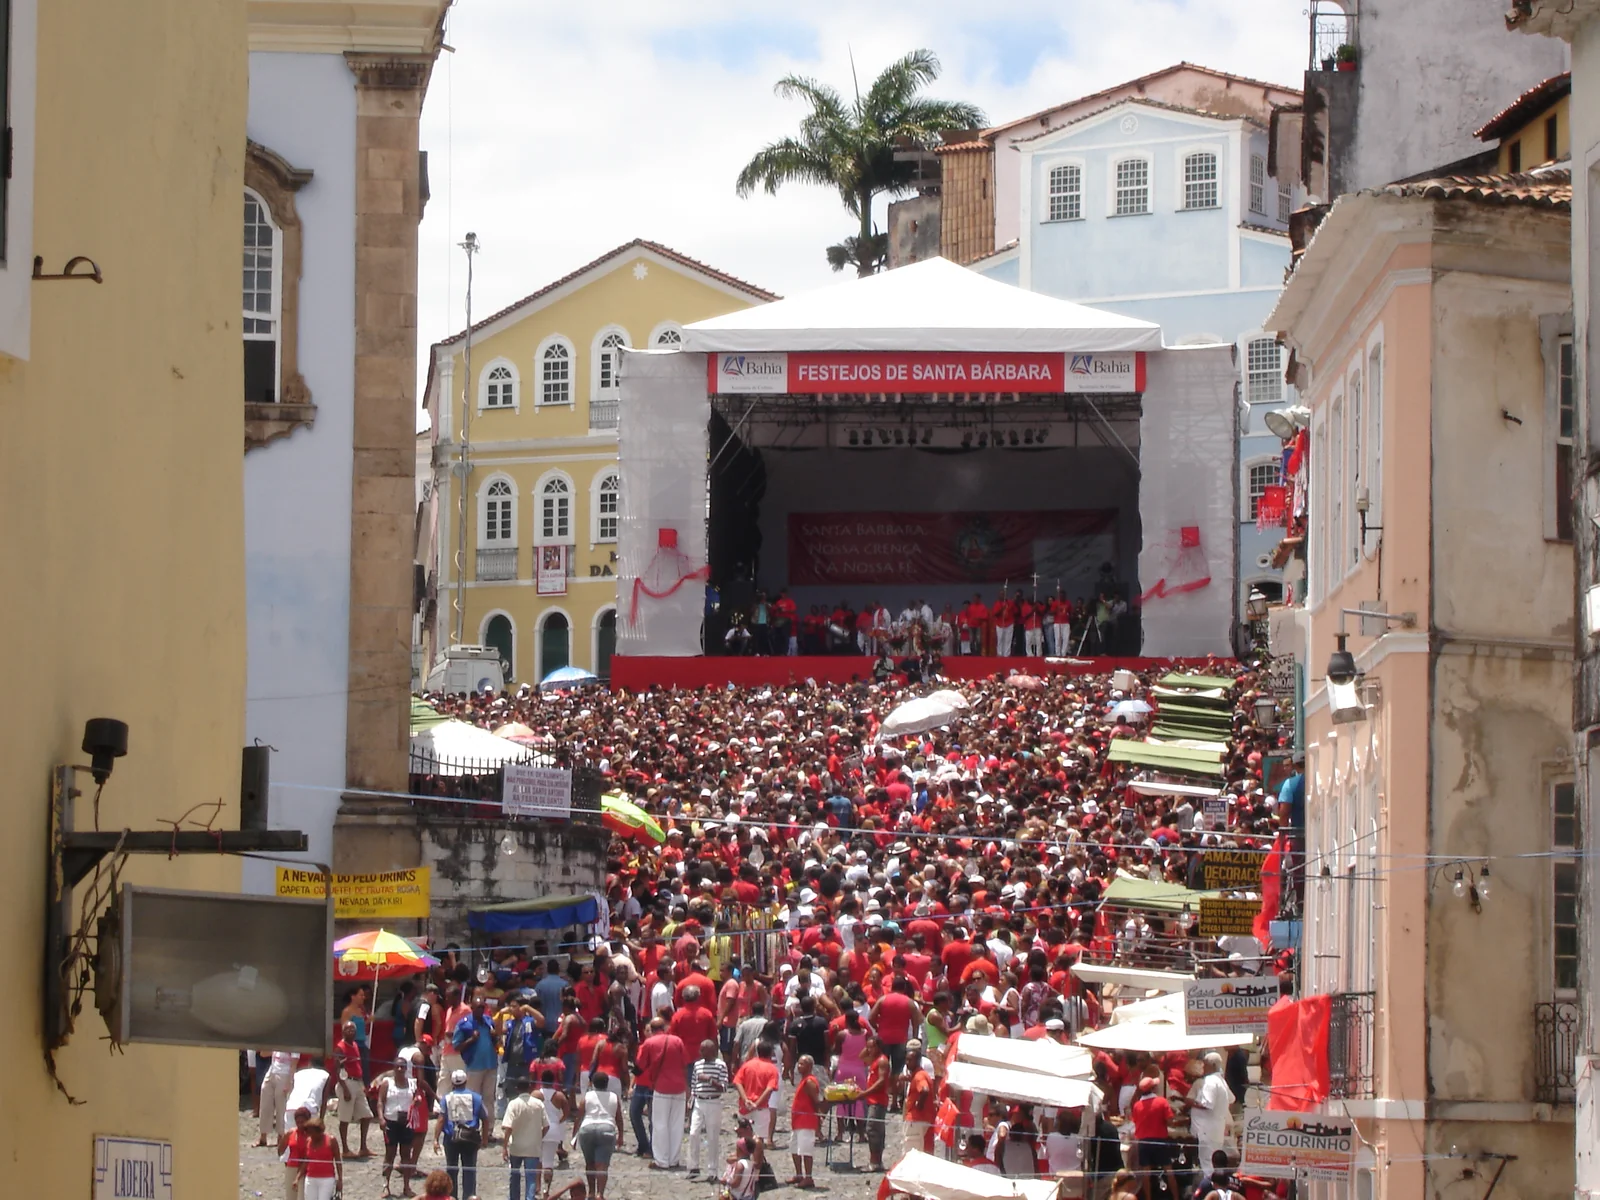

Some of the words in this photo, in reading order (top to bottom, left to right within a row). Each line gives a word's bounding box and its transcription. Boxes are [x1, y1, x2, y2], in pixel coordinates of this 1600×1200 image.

[746, 362, 782, 375] Bahia
[798, 364, 881, 381] FESTEJOS
[886, 364, 908, 381] DE
[912, 364, 967, 381] SANTA
[971, 360, 1052, 381] BÁRBARA
[1094, 360, 1130, 374] Bahia
[801, 522, 852, 536] SANTA
[809, 542, 860, 555] NOSSA
[590, 564, 613, 577] DA
[843, 561, 894, 574] NOSSA
[282, 870, 289, 882] A
[292, 871, 334, 883] NEVAD
[337, 873, 350, 883] DO
[353, 873, 377, 883] PELO
[380, 869, 416, 882] DRINKS
[280, 885, 310, 895] CAPETA
[355, 886, 364, 895] DE
[367, 885, 394, 894] FRUTAS
[339, 897, 370, 906] NEVADA
[1187, 985, 1215, 998] Casa
[1187, 996, 1278, 1010] PELOURINHO
[1247, 1116, 1280, 1132] Casa
[1246, 1132, 1351, 1152] PELOURINHO
[114, 1158, 155, 1199] LADEIRA
